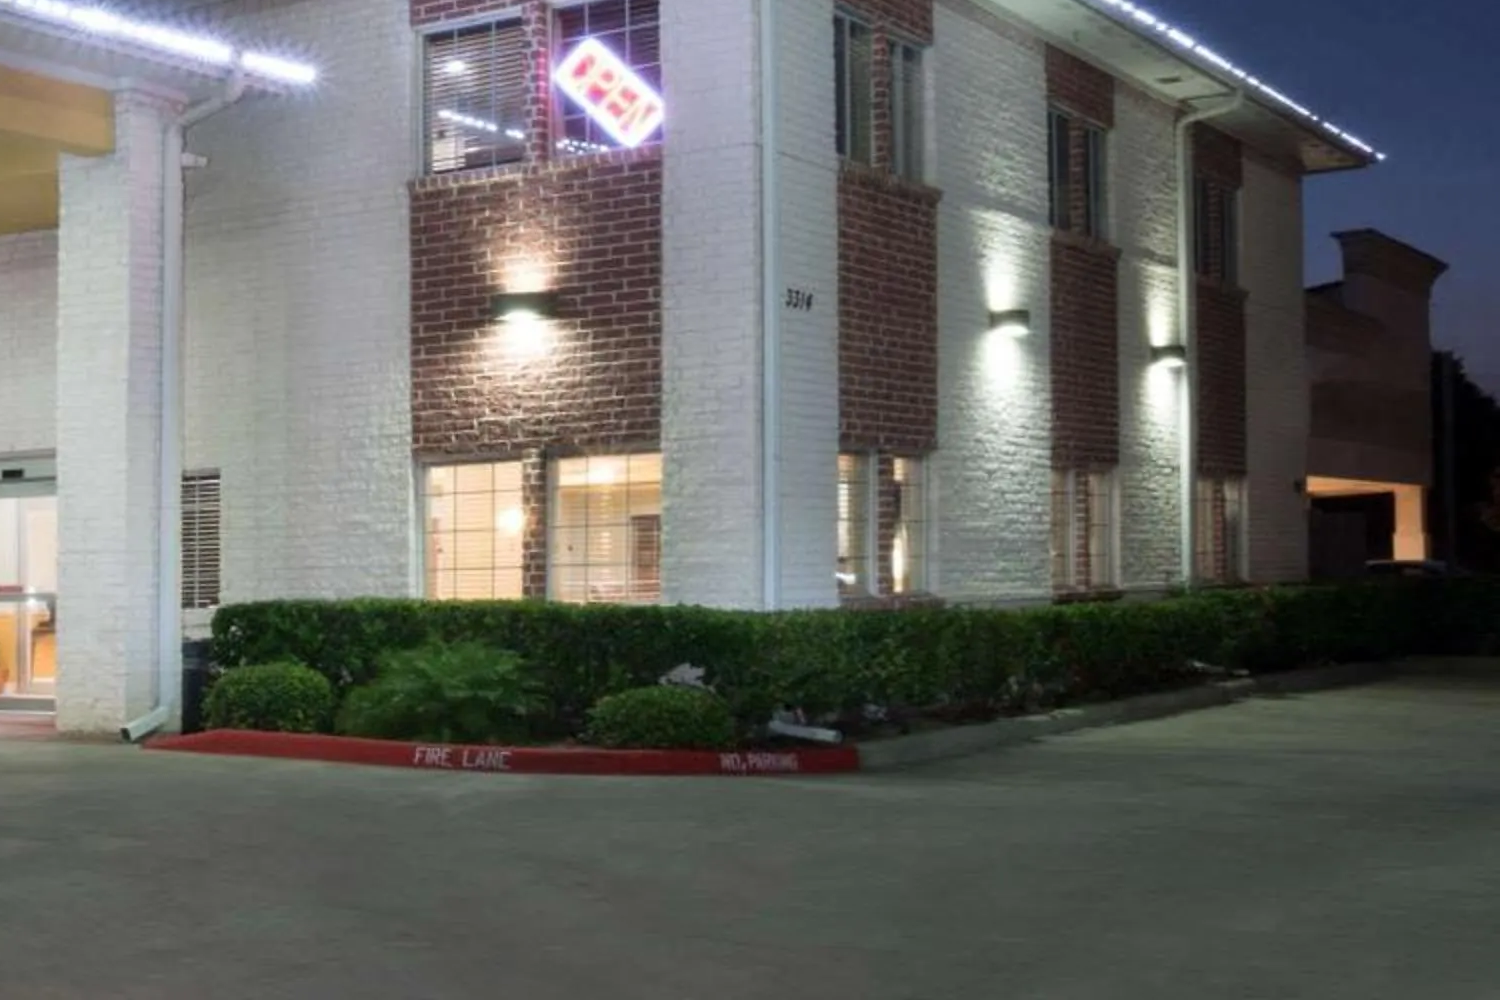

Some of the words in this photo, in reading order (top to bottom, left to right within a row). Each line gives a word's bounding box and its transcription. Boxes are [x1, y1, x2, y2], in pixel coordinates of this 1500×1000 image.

[561, 42, 660, 144] OPEN
[413, 747, 453, 767] FIRE
[462, 749, 512, 770] LANE
